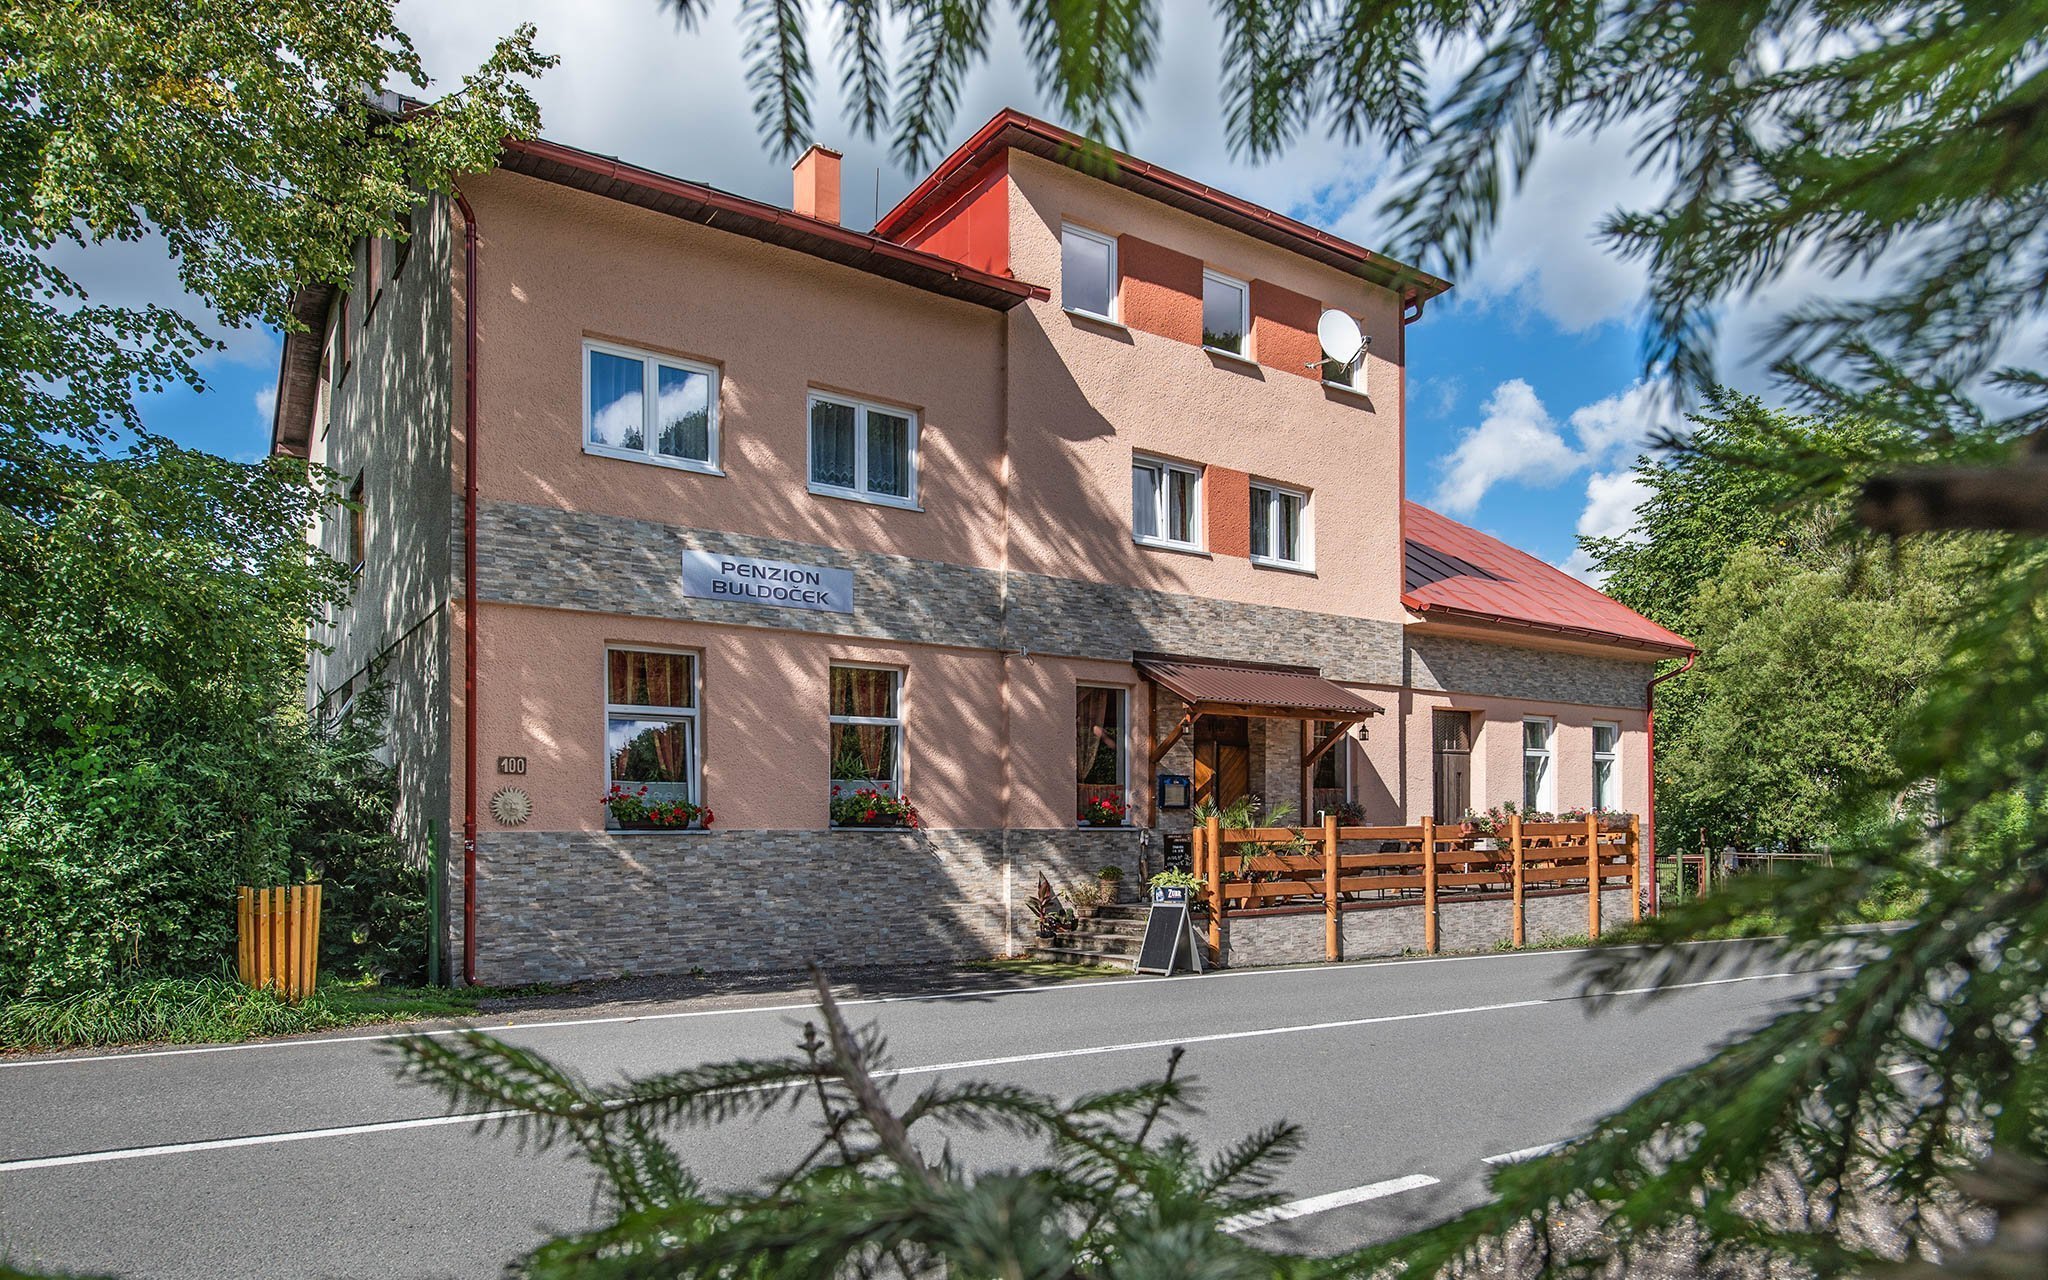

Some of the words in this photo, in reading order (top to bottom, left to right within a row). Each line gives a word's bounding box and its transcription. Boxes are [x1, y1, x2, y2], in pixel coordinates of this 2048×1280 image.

[721, 561, 820, 585] PENZION
[712, 579, 829, 605] BULDOČEK
[501, 758, 525, 773] 100
